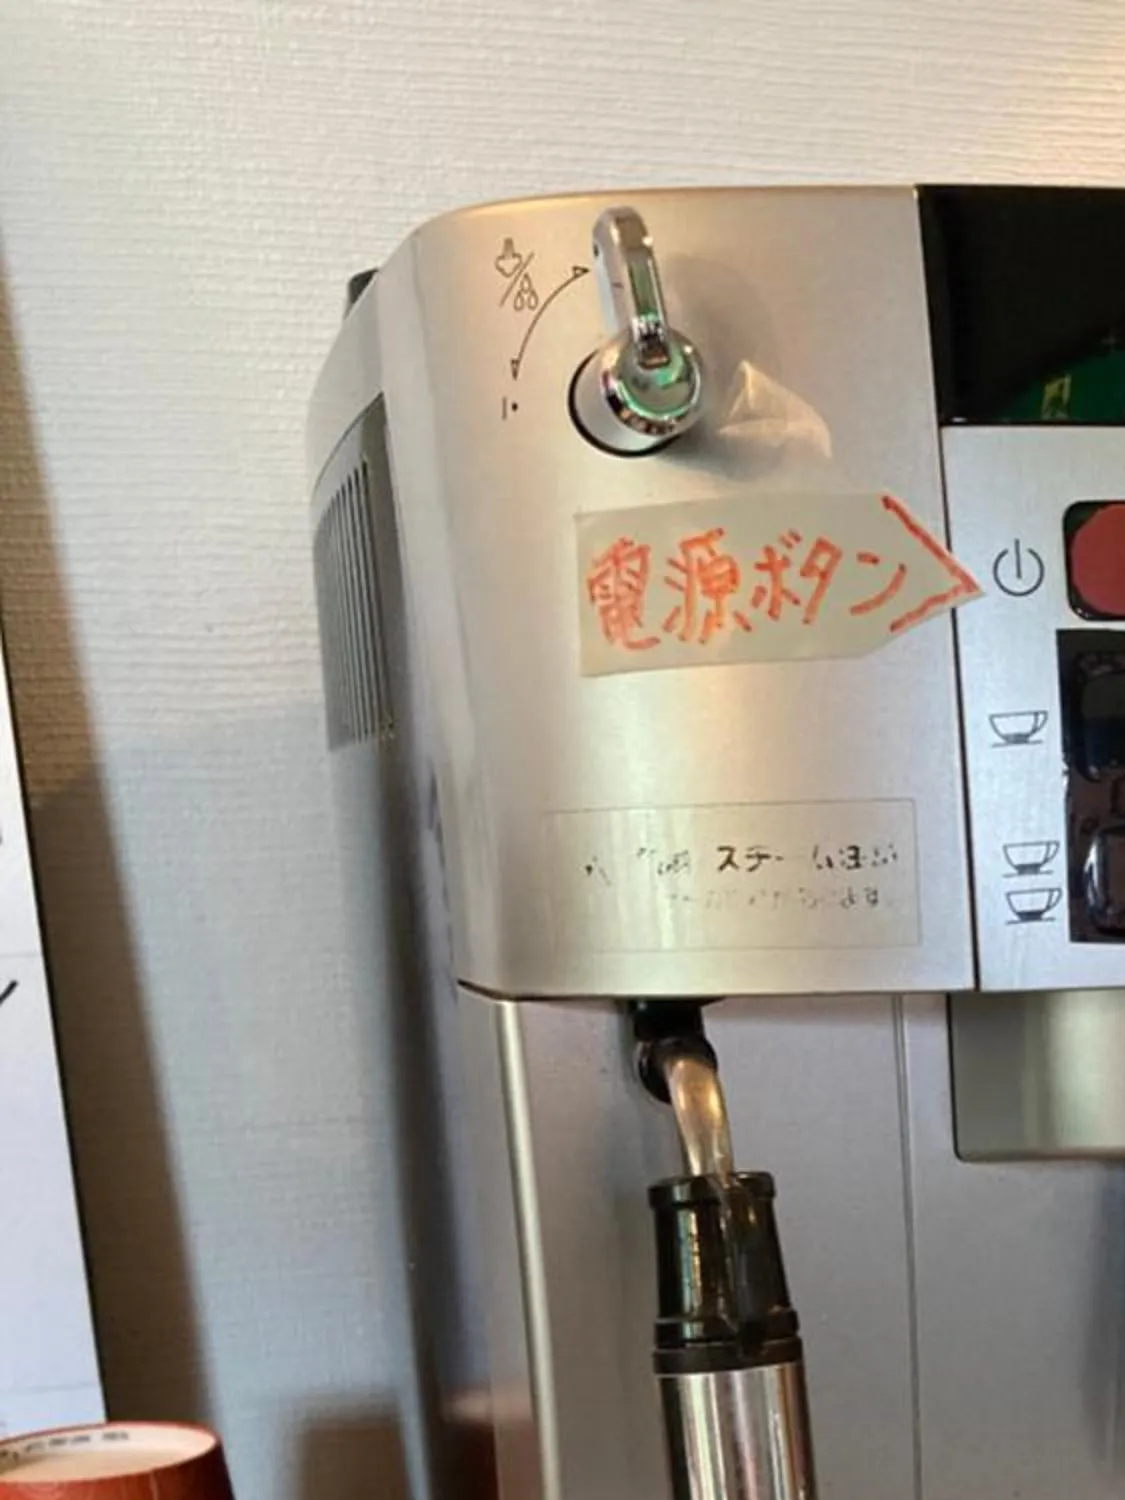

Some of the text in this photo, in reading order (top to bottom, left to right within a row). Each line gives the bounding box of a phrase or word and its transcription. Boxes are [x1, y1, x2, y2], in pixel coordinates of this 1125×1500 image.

[587, 528, 906, 649] 電源ボタン
